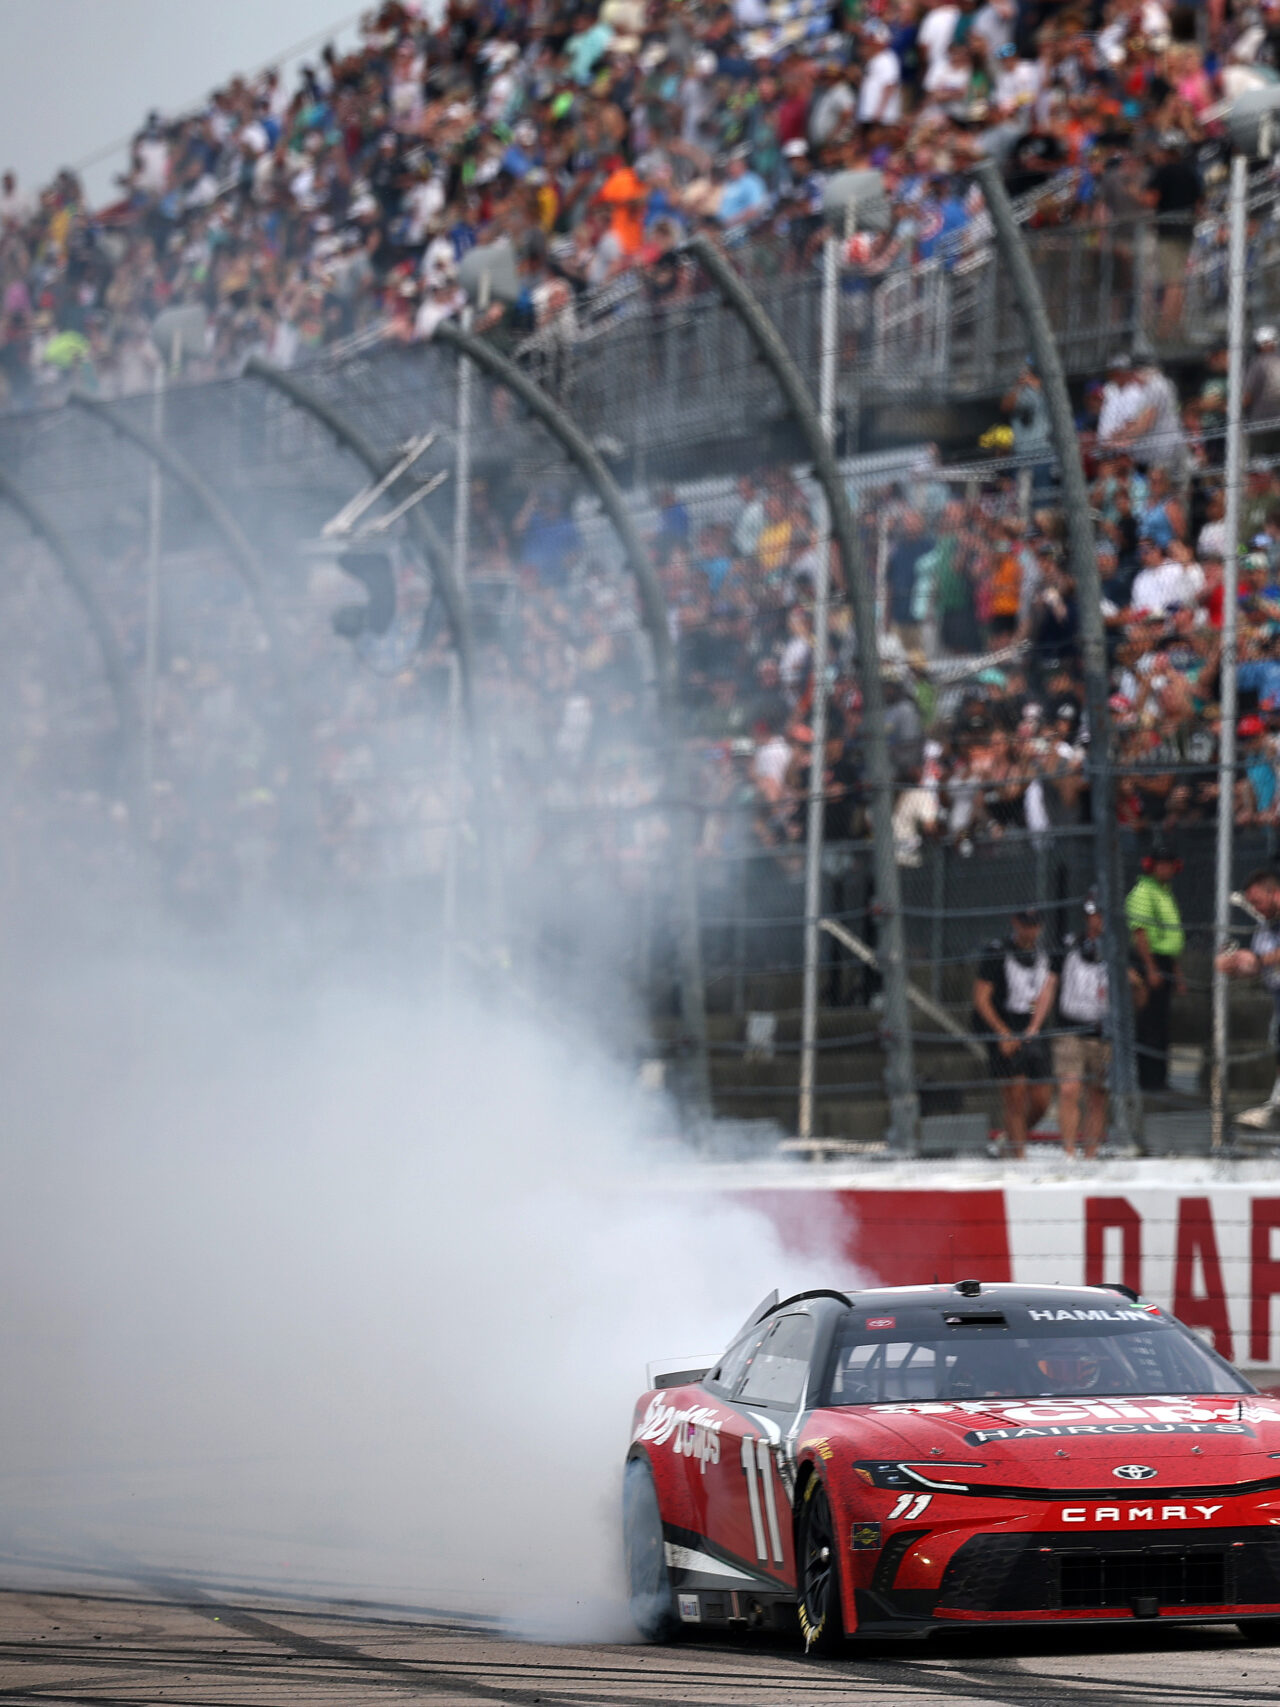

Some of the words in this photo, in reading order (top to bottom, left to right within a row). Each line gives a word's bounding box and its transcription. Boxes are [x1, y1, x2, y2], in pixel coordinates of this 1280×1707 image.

[1028, 1309, 1152, 1323] HAMLIN
[975, 1423, 1246, 1442] HAIRCUTS
[741, 1435, 784, 1563] 11
[886, 1493, 934, 1520] 11
[1061, 1504, 1224, 1523] CAMRY
